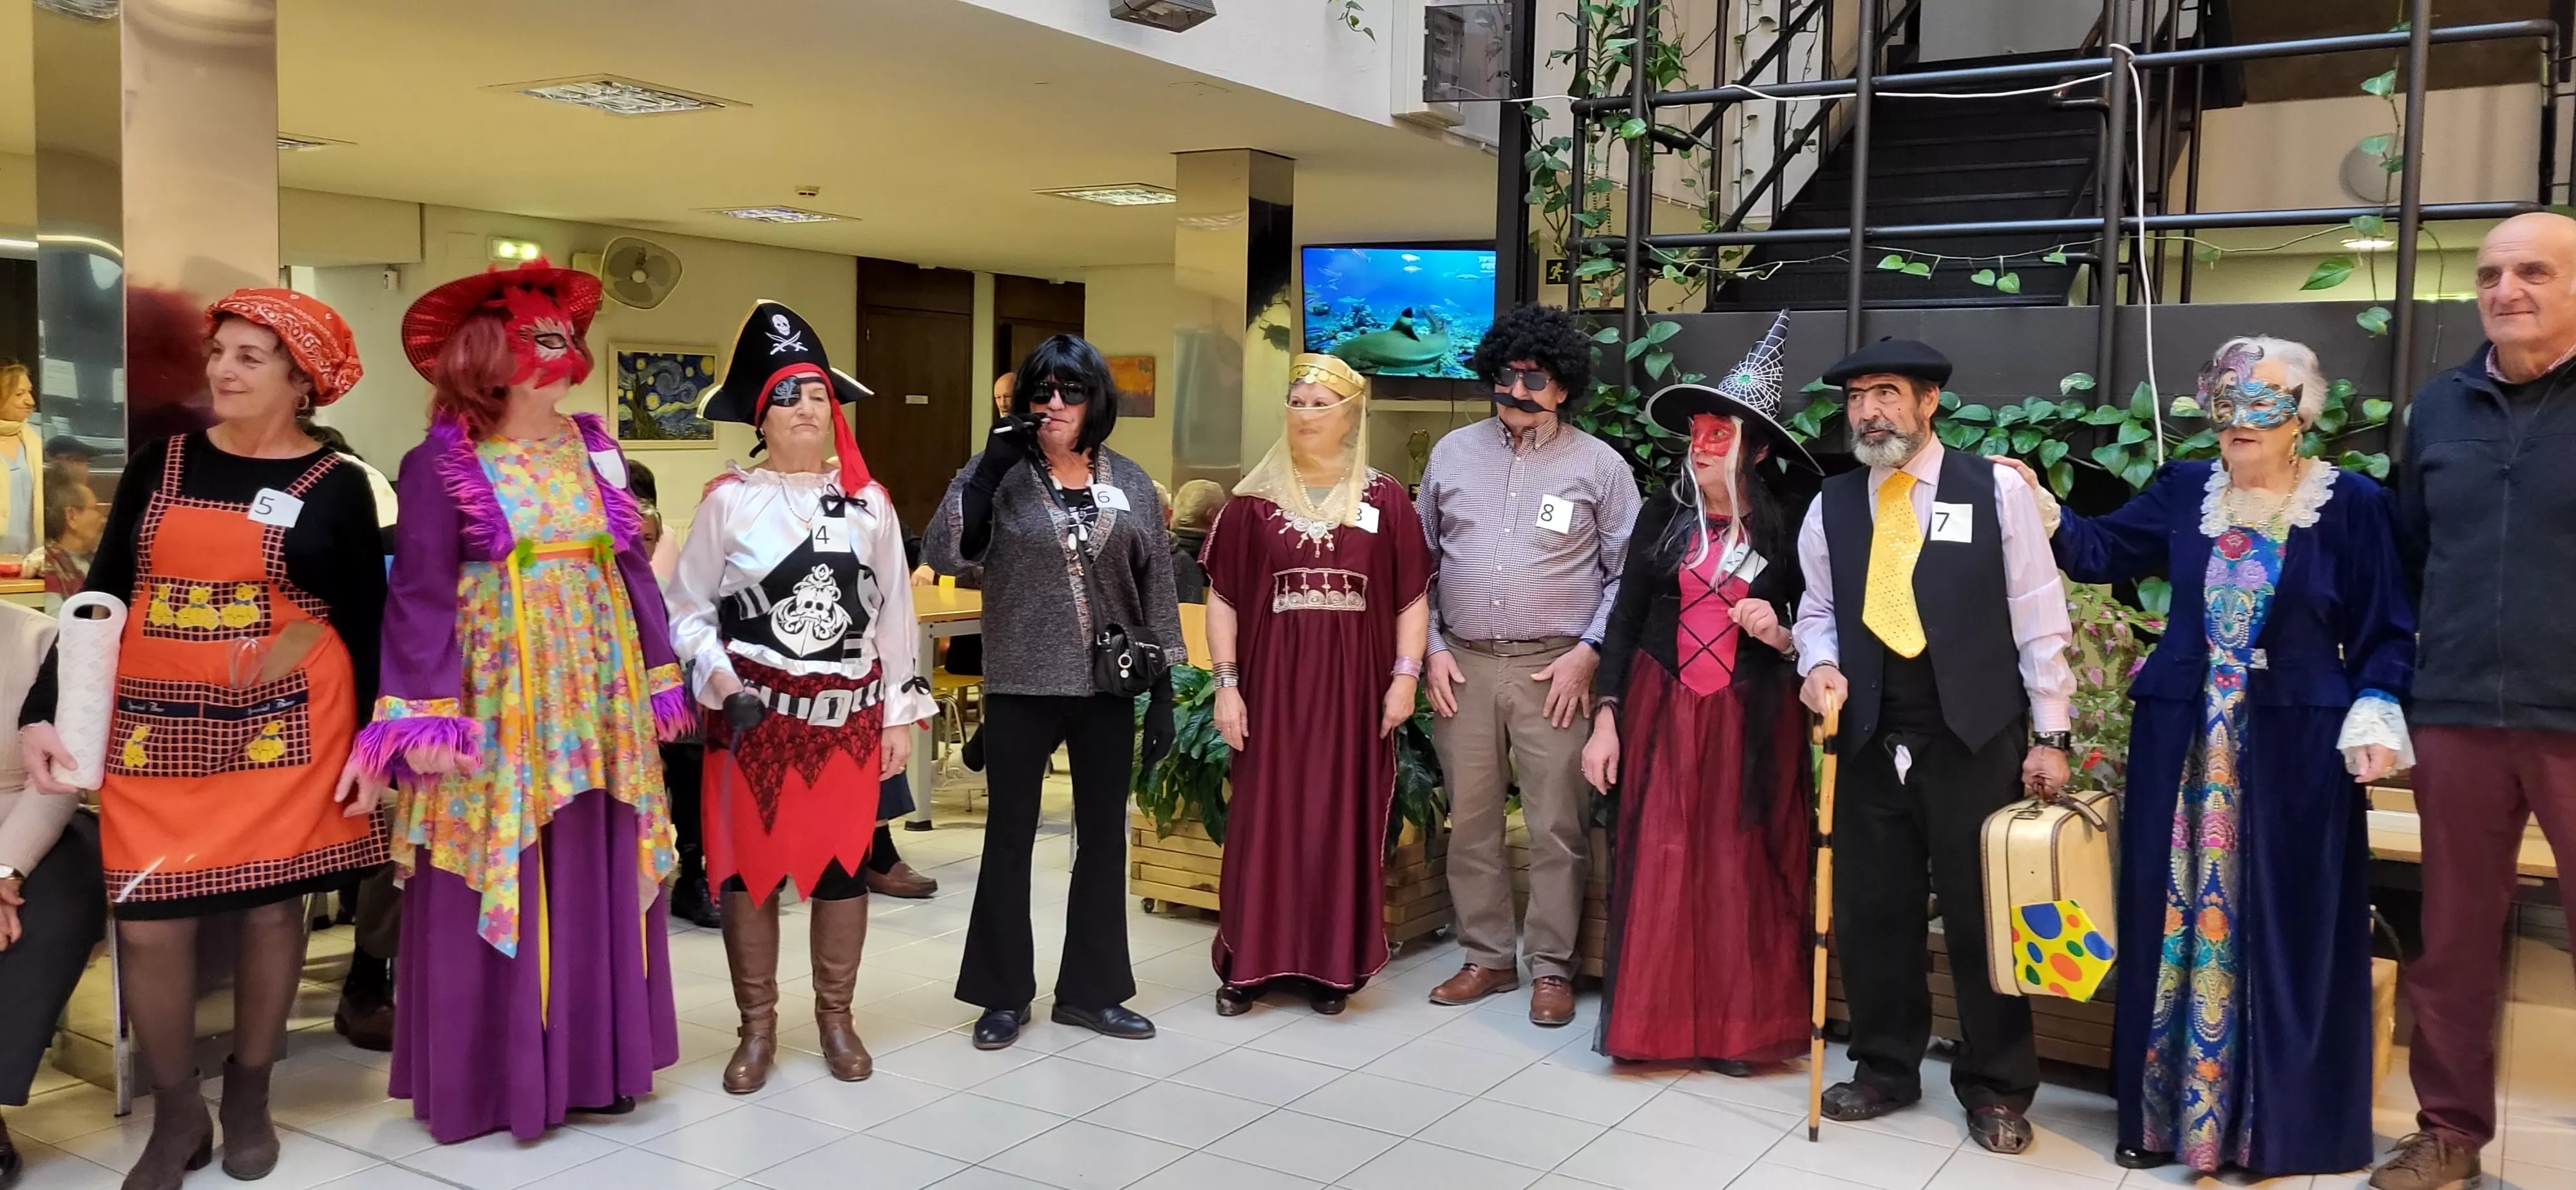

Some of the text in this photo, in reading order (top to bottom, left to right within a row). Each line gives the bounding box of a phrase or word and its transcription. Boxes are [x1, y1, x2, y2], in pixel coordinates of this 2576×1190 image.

[254, 496, 275, 515] 5
[1097, 491, 1110, 503] 6
[1540, 504, 1554, 522] 8
[1935, 512, 1950, 532] 7
[815, 525, 830, 544] 4
